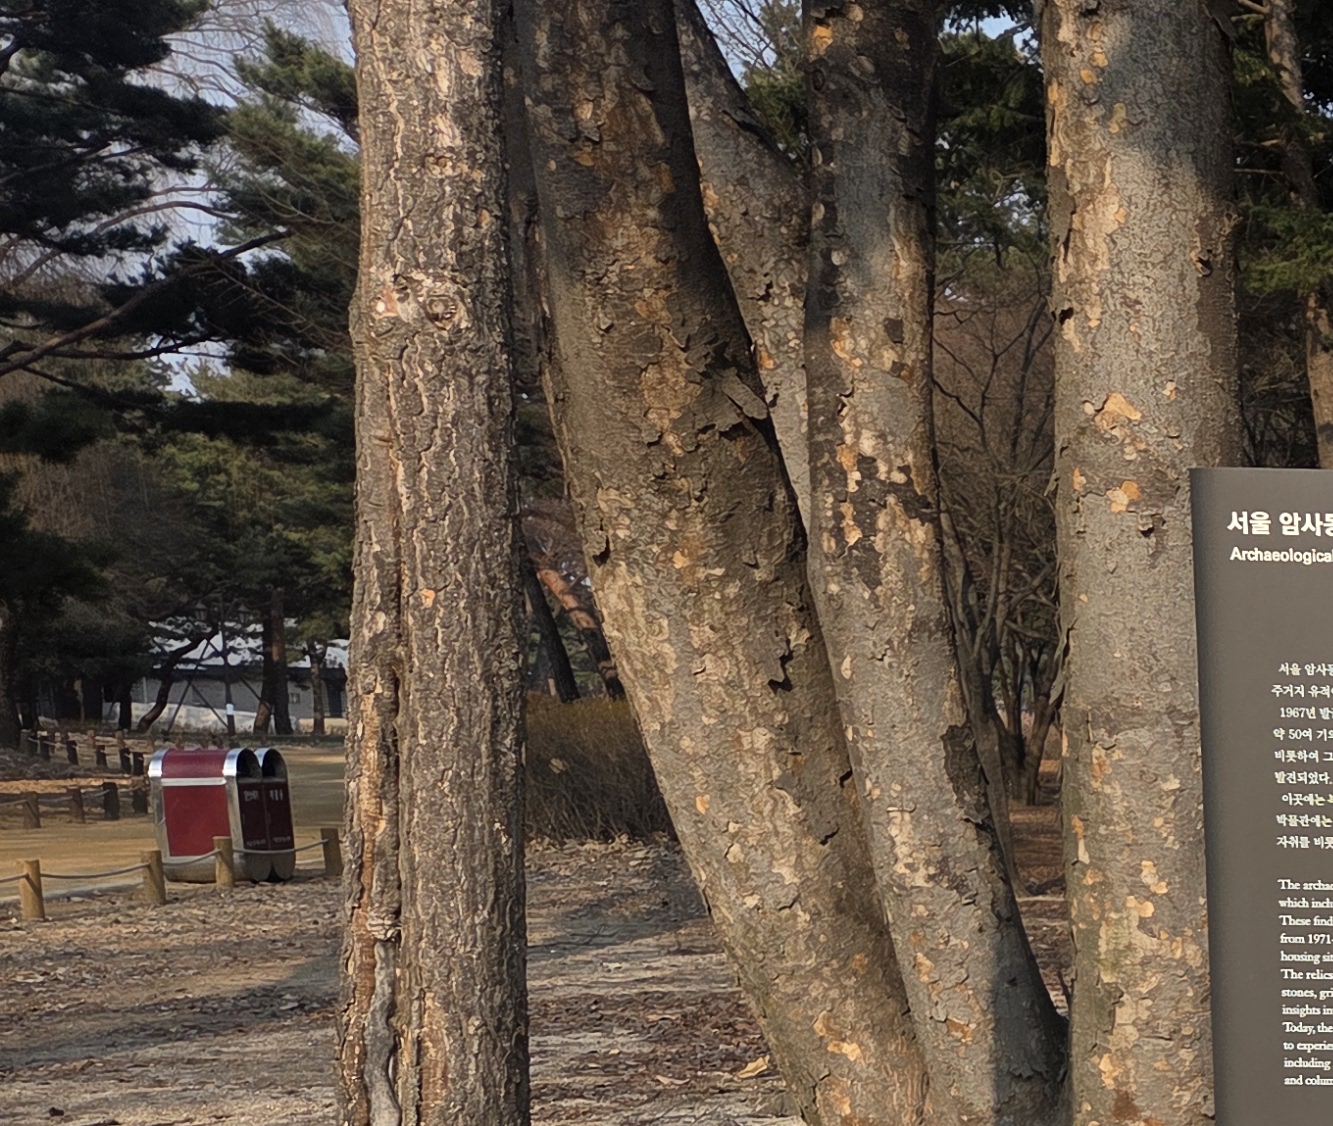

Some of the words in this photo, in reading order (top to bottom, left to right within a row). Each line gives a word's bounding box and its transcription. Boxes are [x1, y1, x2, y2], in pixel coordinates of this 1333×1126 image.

[1226, 510, 1271, 535] 서울
[1277, 661, 1301, 676] 서울
[1270, 683, 1304, 698] 주거지
[1279, 705, 1316, 719] 1967년
[1273, 770, 1333, 784] 발견되었다.
[1276, 878, 1300, 890] The
[1277, 896, 1309, 908] which
[1279, 949, 1321, 965] housing
[1283, 1073, 1303, 1085] and
